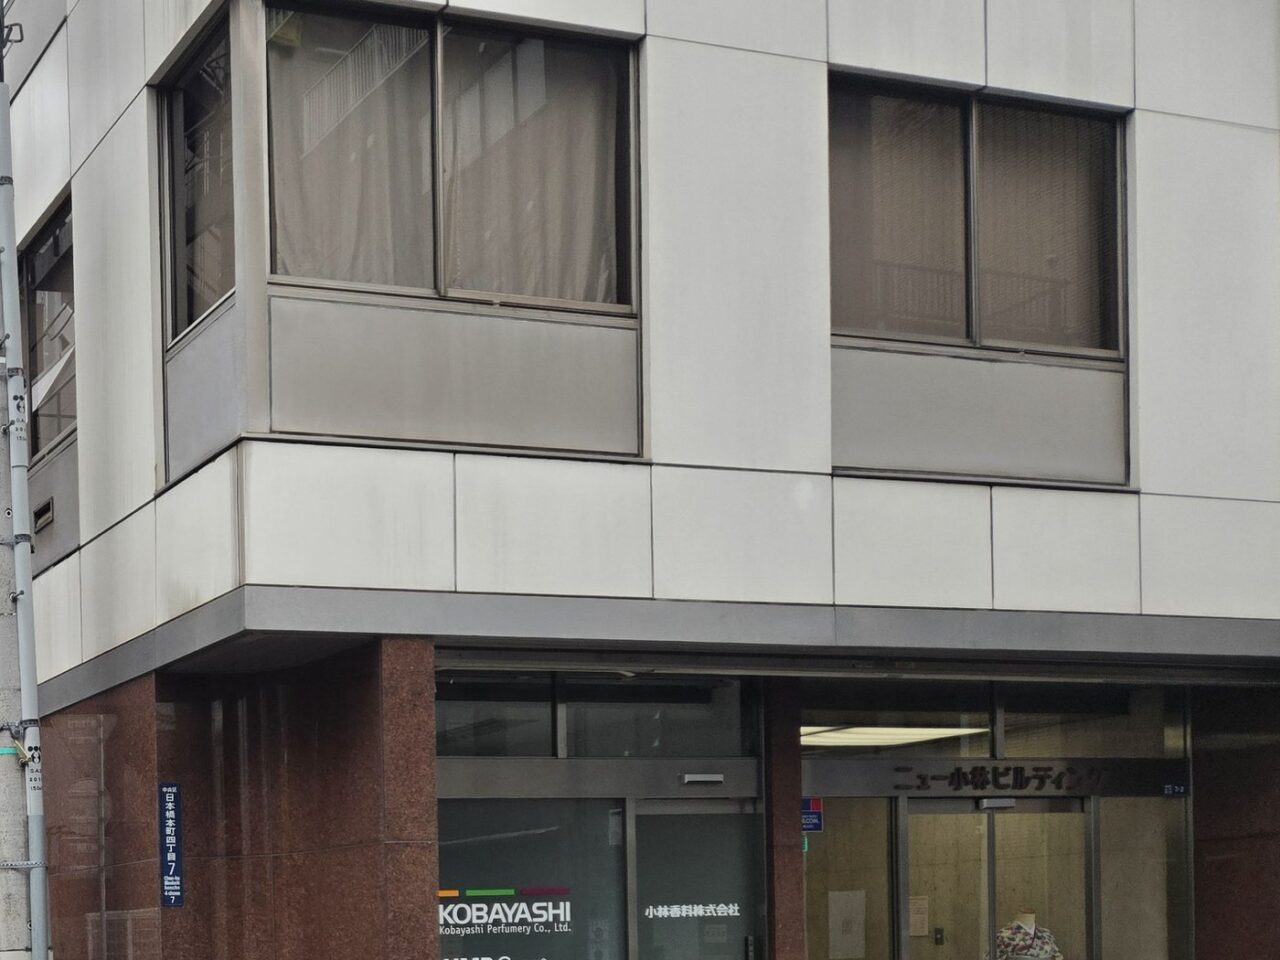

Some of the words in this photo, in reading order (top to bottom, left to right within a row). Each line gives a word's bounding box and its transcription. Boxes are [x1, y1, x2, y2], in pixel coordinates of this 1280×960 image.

[165, 793, 176, 861] 日本橋本町四丁目
[167, 862, 176, 876] 7
[438, 901, 571, 925] KOBAYASHI
[644, 903, 741, 919] 小林香料株式会社
[439, 924, 484, 937] Kobayashi
[487, 923, 531, 935] Perfumery
[554, 922, 572, 932] Ltd.
